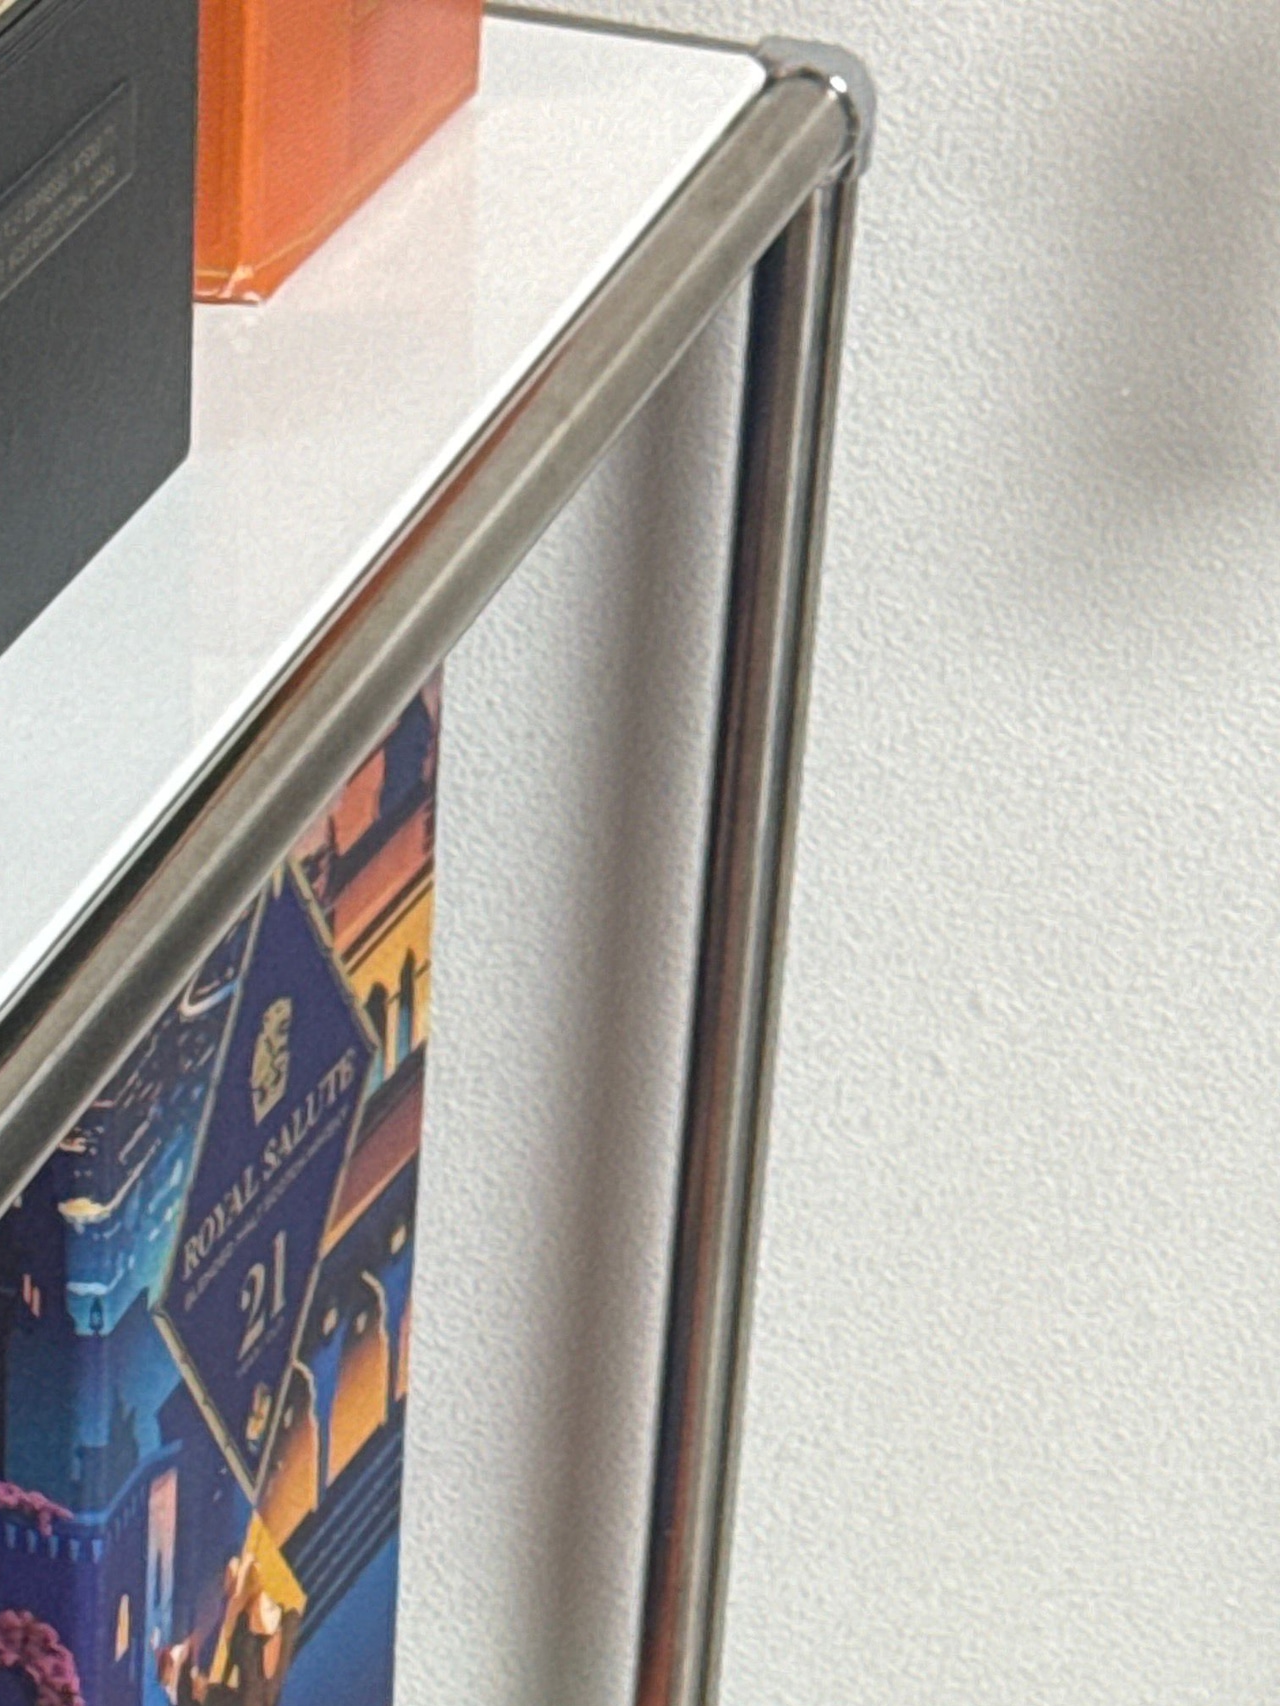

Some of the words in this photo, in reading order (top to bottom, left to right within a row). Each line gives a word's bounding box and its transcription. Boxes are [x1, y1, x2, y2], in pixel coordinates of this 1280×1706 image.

[181, 1163, 261, 1283] ROYAL
[263, 1053, 356, 1183] SALUTE
[237, 1230, 287, 1362] 21
